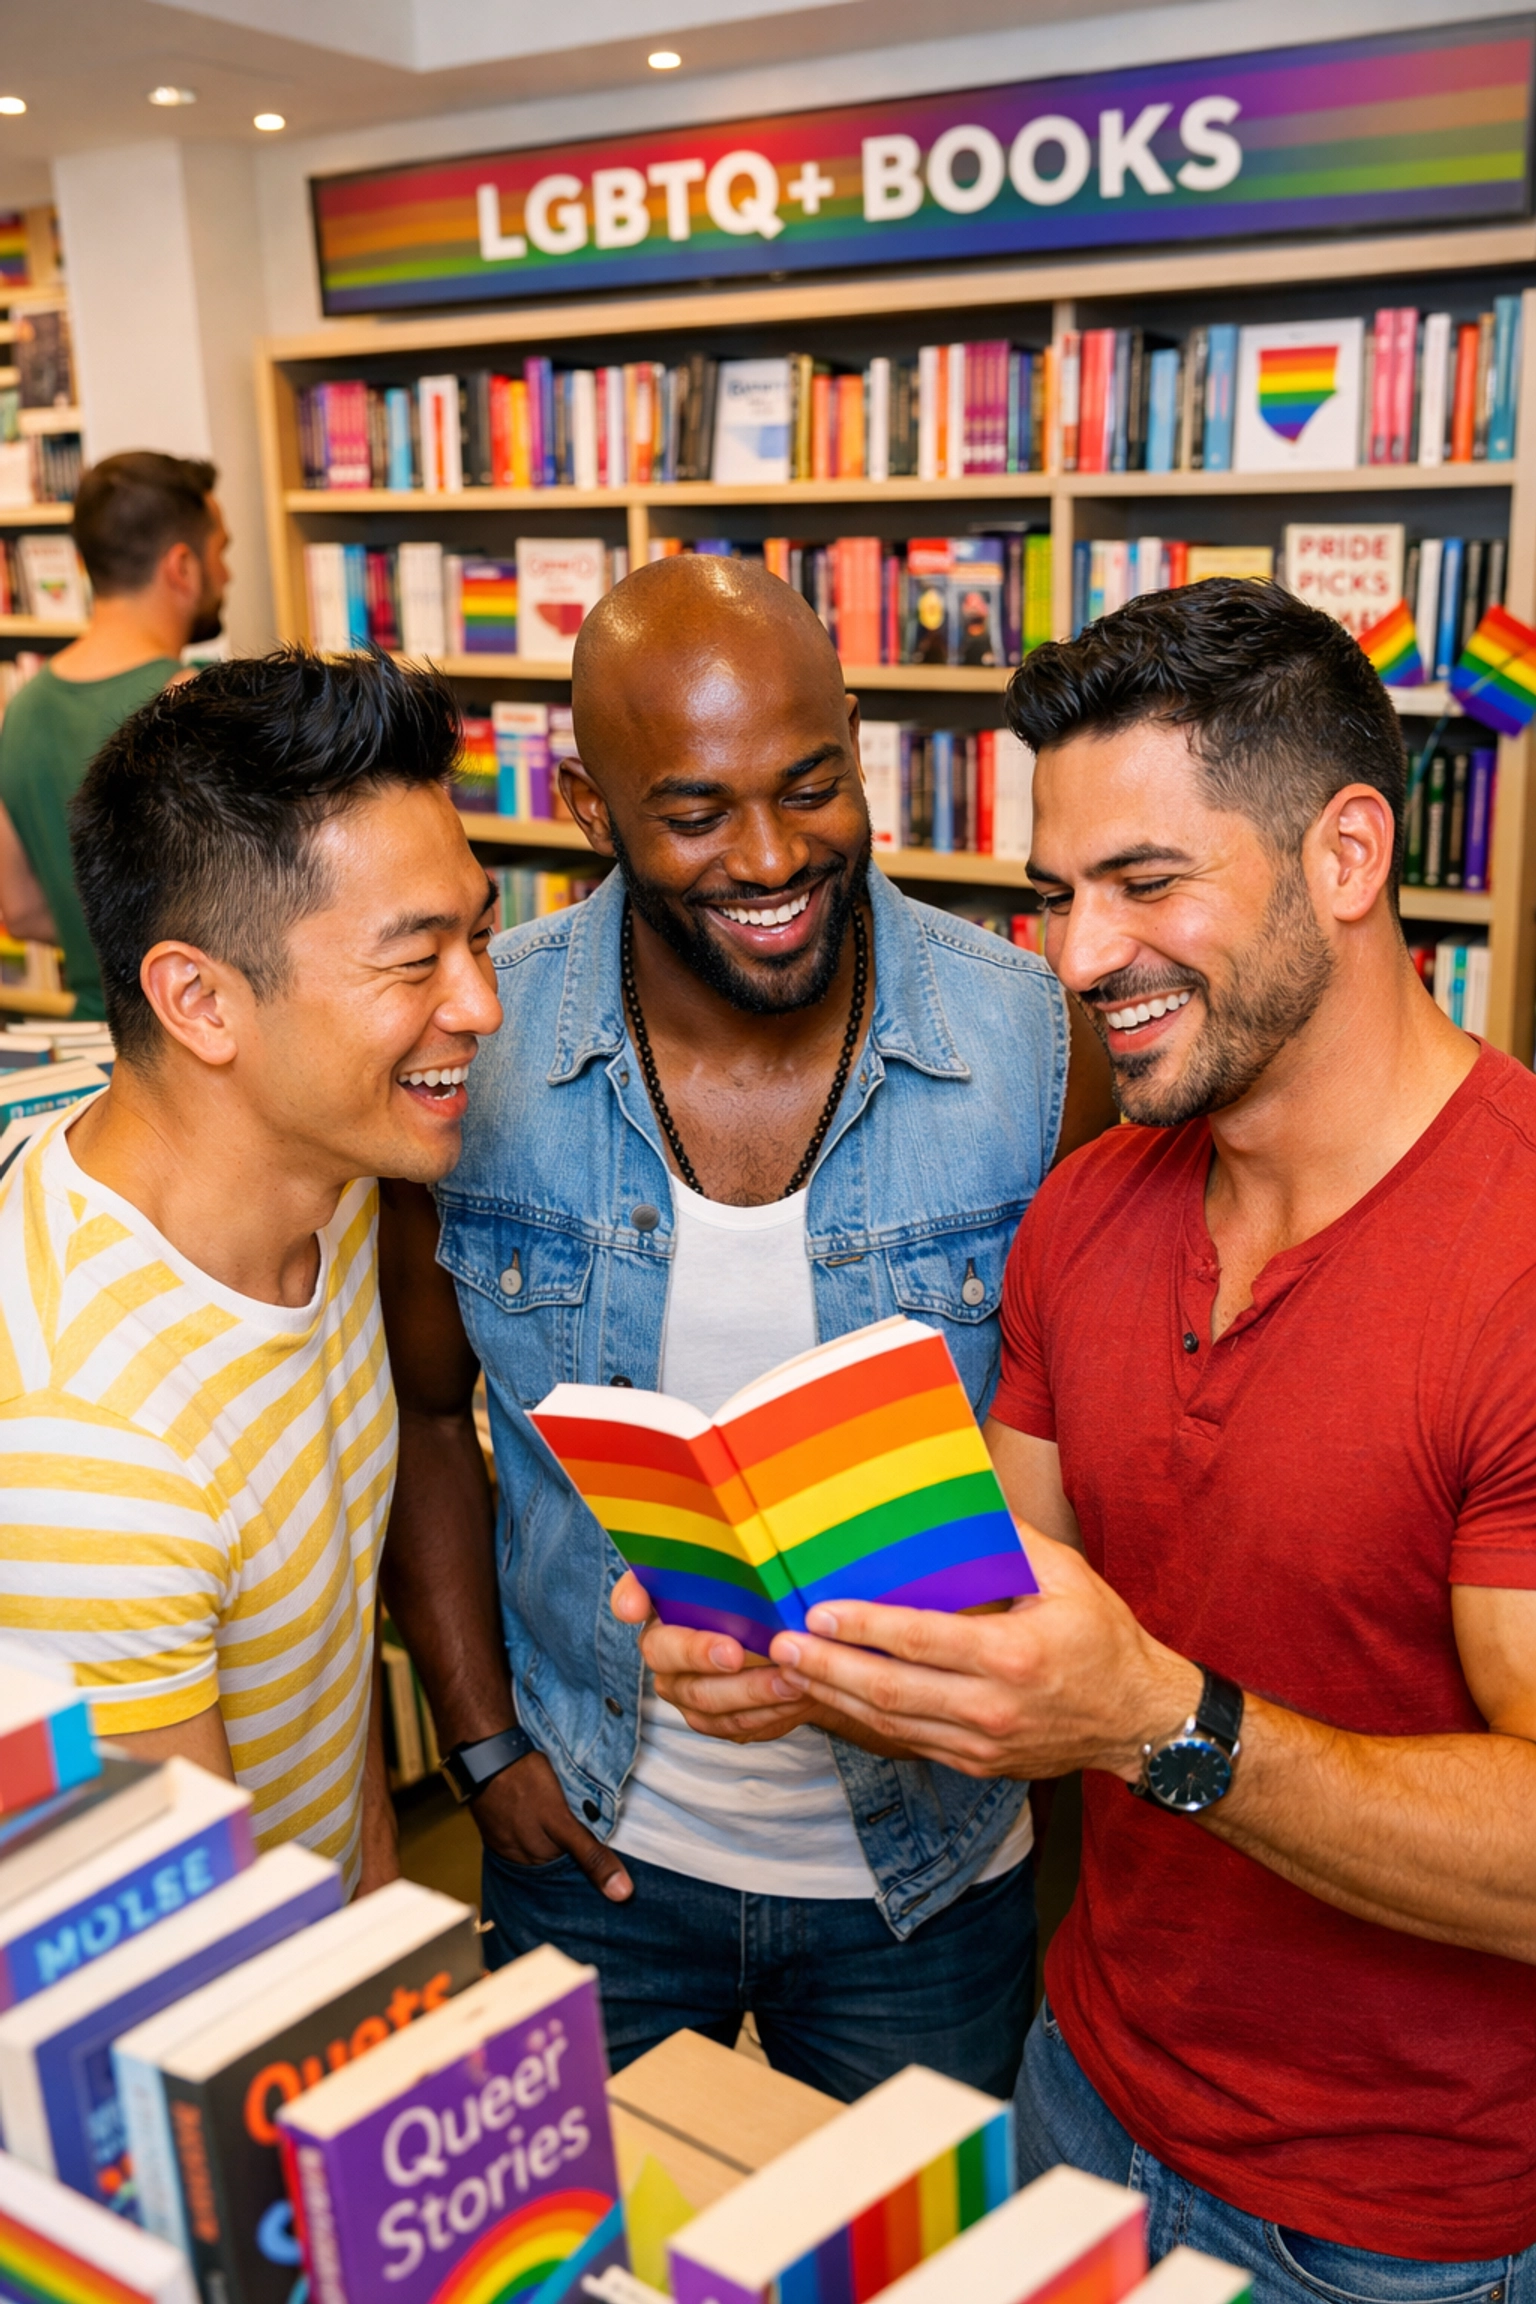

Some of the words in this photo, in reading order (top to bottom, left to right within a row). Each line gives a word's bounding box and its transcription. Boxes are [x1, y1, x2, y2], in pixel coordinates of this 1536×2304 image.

[477, 150, 835, 263] LGBTQ+
[861, 95, 1242, 222] BOOKS
[1298, 534, 1389, 561] PRIDE
[1298, 569, 1389, 597] PICKS
[377, 2105, 591, 2283] Stories
